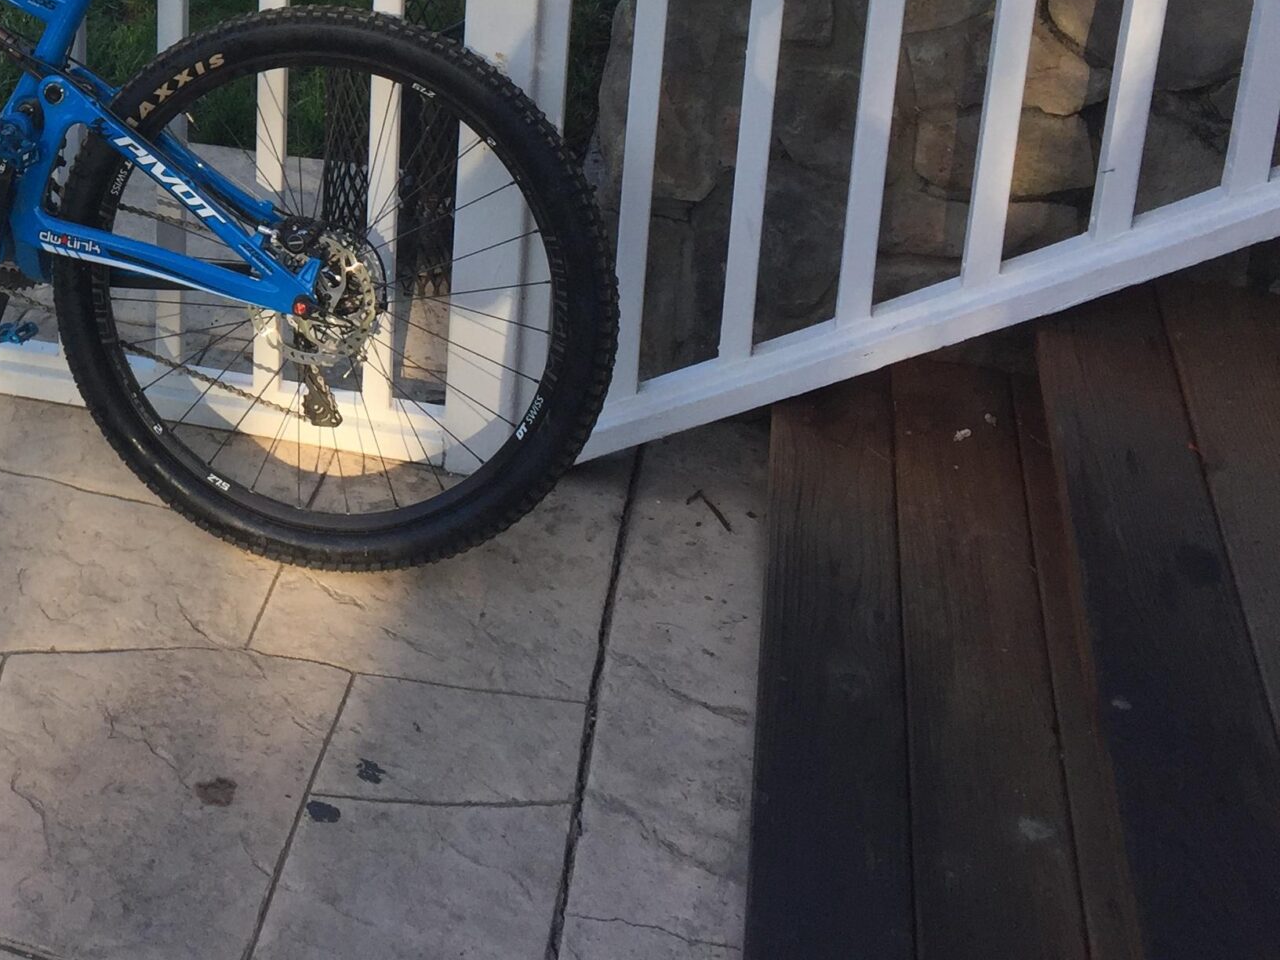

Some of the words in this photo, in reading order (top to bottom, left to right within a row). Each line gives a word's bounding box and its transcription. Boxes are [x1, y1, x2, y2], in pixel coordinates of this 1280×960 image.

[110, 168, 128, 196] SWISS
[113, 136, 226, 223] PIVOT
[515, 422, 528, 441] DT
[525, 394, 544, 425] SWISS
